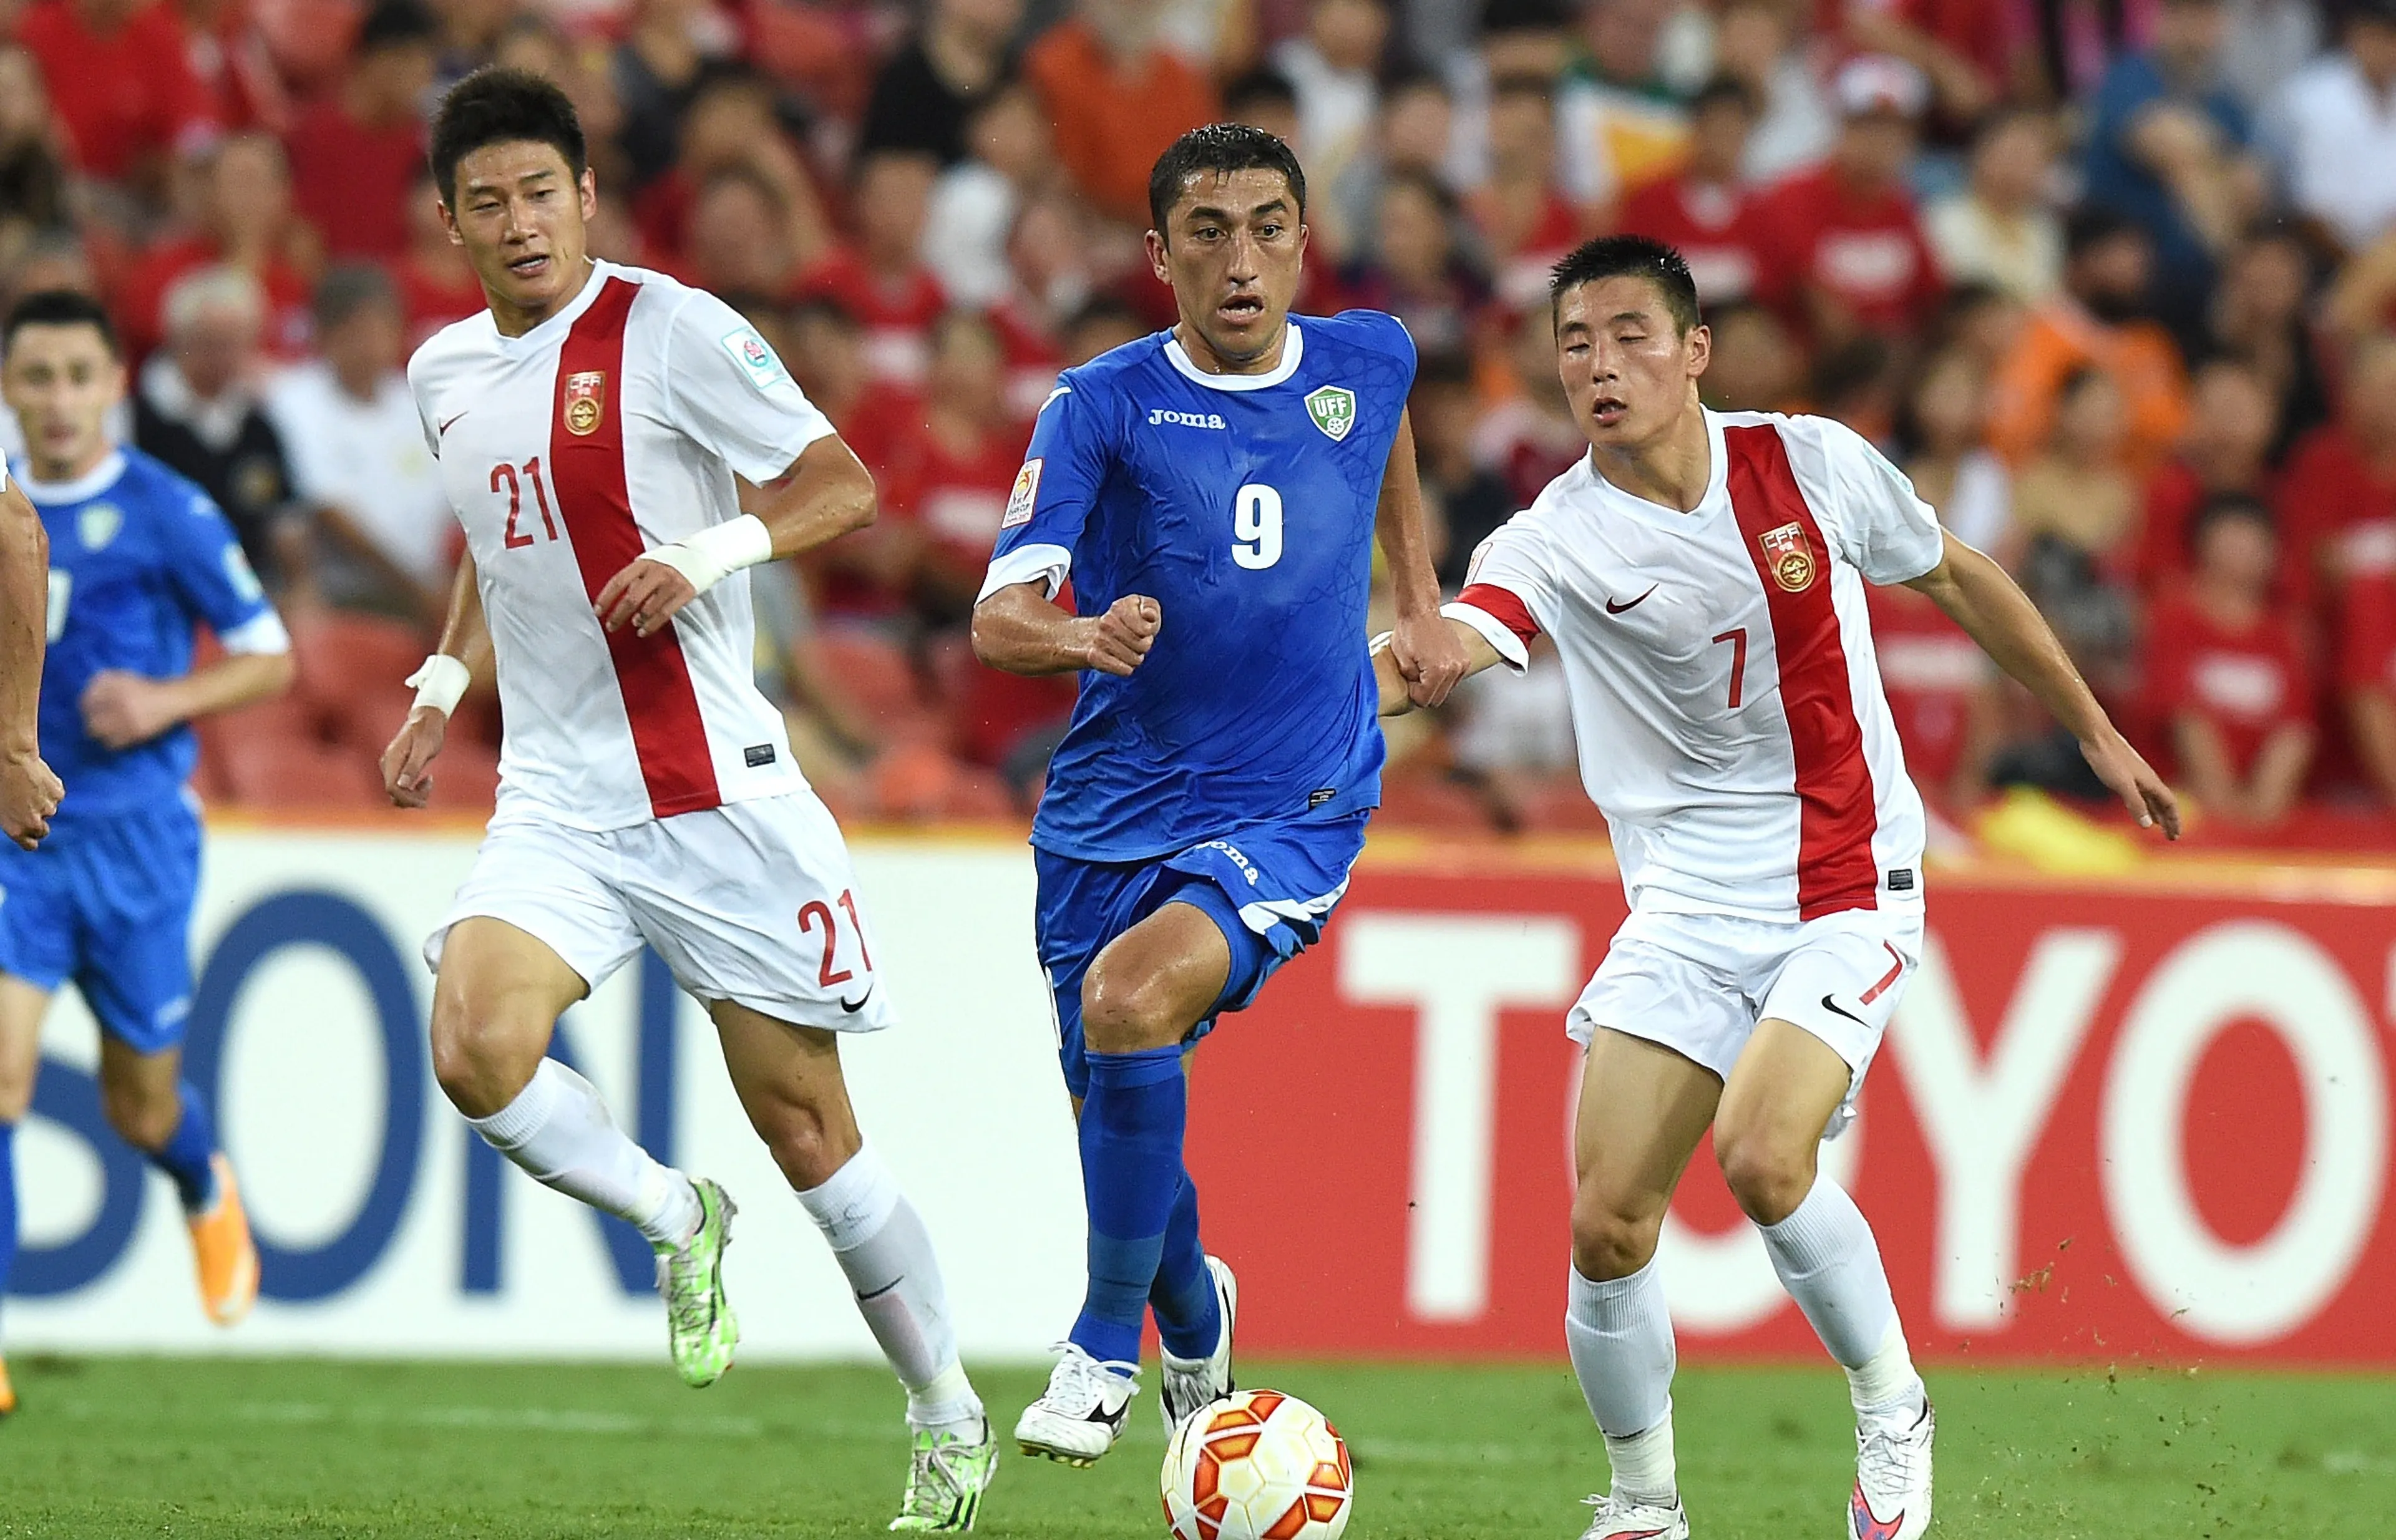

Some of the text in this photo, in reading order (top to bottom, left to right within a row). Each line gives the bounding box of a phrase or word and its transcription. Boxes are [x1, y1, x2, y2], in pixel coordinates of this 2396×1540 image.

[1148, 409, 1226, 429] Joma
[1314, 396, 1347, 417] UFF
[490, 456, 558, 549] 21
[1231, 484, 1283, 569] 9
[1712, 628, 1747, 709] 7
[797, 889, 873, 988] 21
[1859, 938, 1903, 1006] 7
[1338, 914, 2396, 1347] TYO
